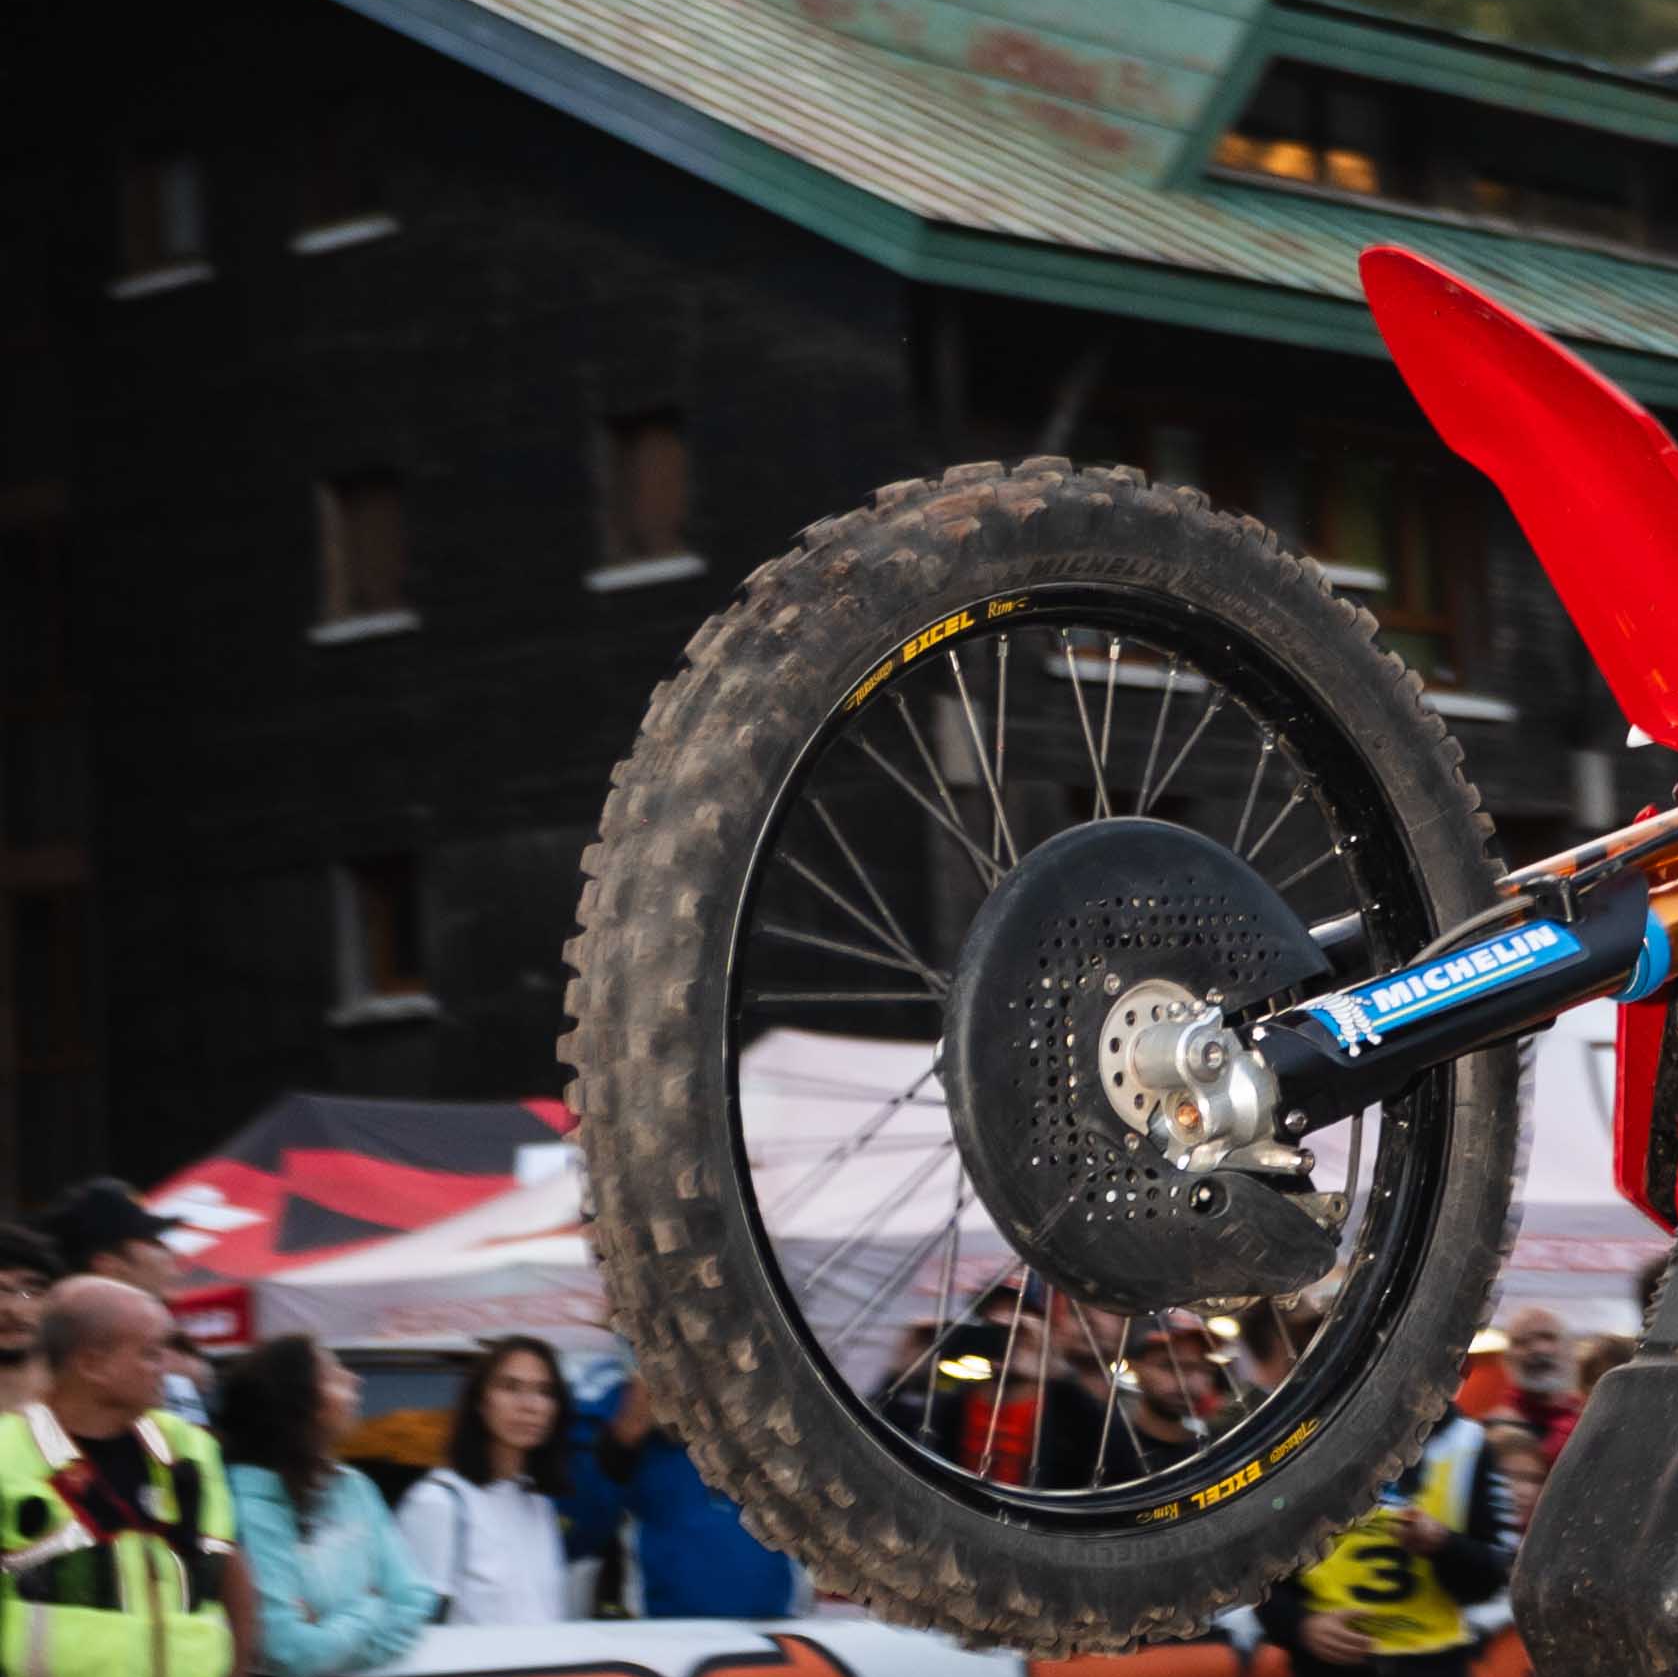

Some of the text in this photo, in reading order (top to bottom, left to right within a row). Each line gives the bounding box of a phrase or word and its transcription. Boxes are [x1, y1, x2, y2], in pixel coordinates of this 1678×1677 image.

[902, 610, 975, 663] EXCEL
[1370, 925, 1558, 1013] MICHELIN
[1190, 1460, 1264, 1509] EXCEL
[1350, 1546, 1417, 1603] 3
